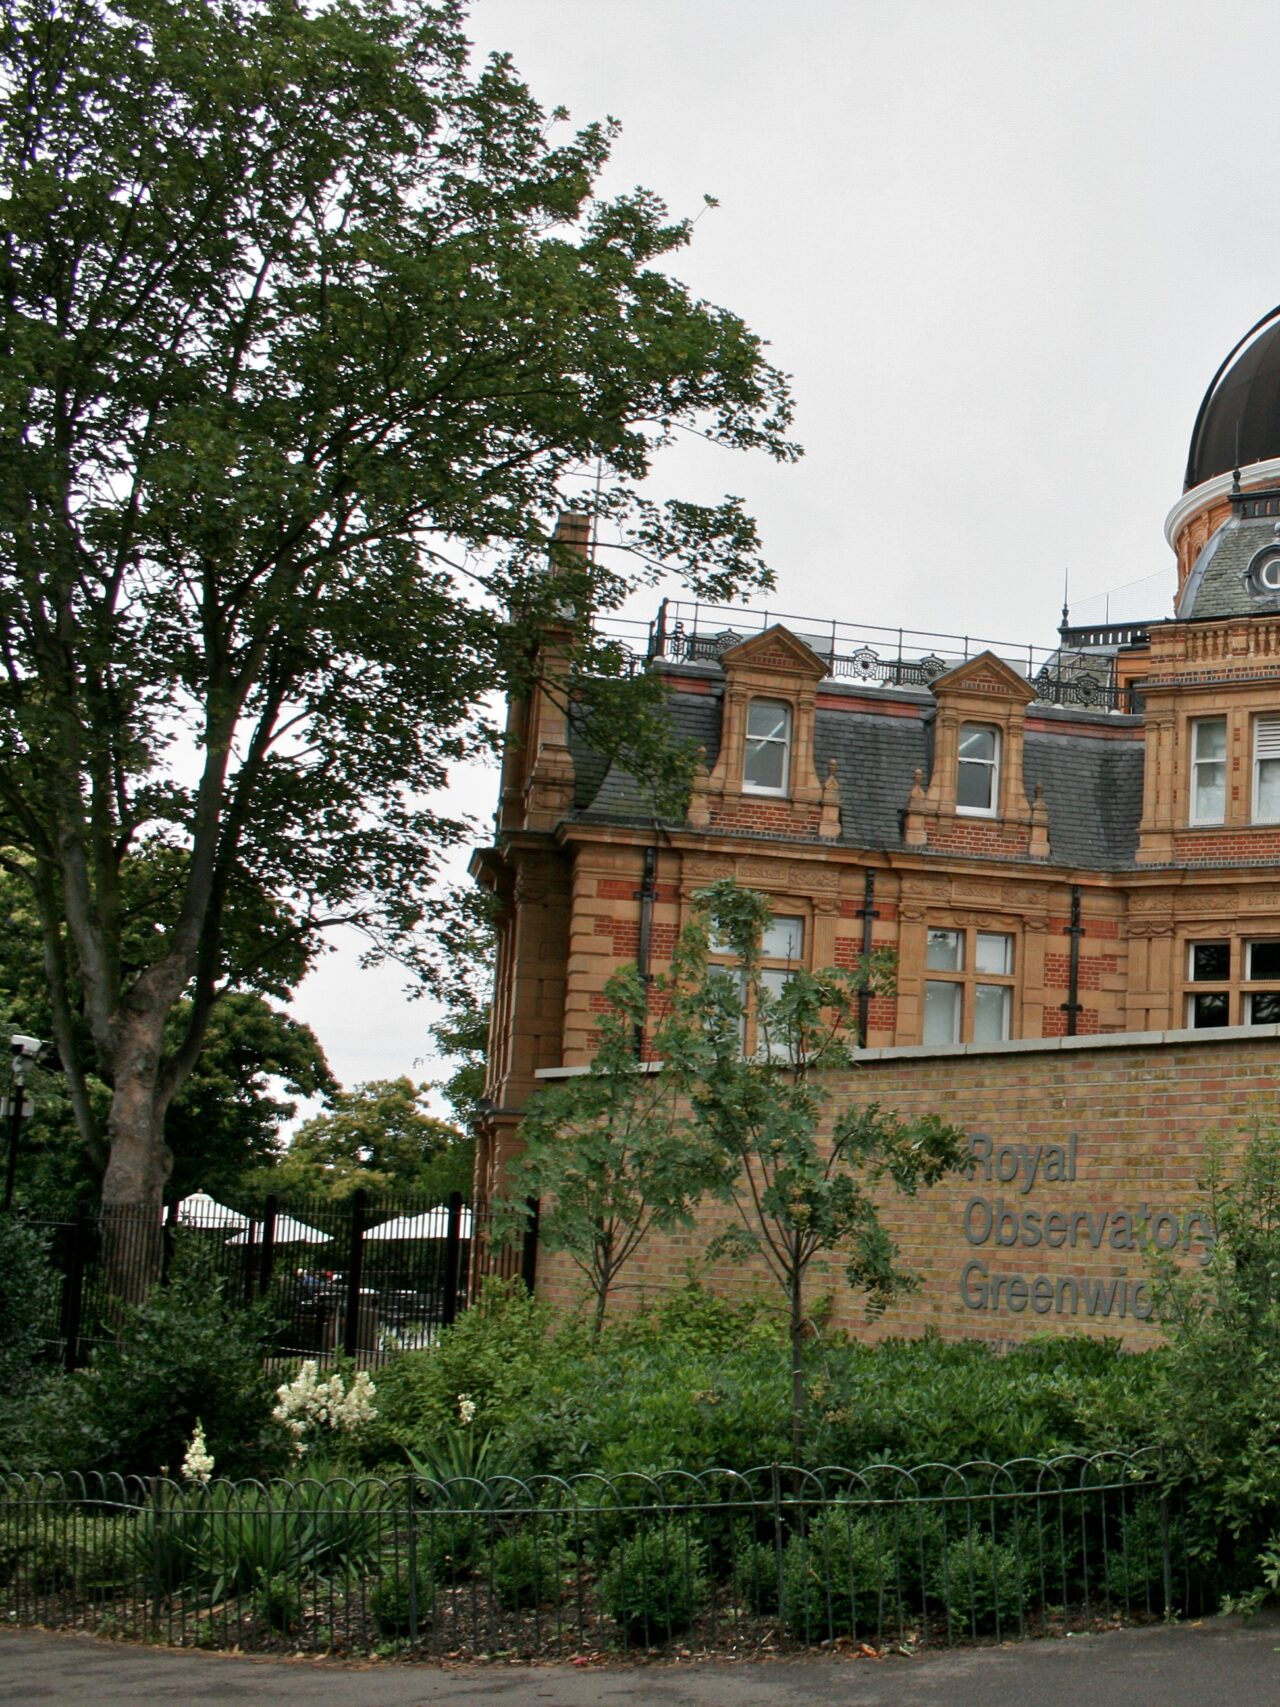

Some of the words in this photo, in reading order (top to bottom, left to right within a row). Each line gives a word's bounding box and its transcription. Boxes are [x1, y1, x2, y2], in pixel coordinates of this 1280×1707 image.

[967, 1132, 1077, 1194] Royal
[963, 1196, 1216, 1265] Observatory
[960, 1259, 1164, 1319] Greenwic
